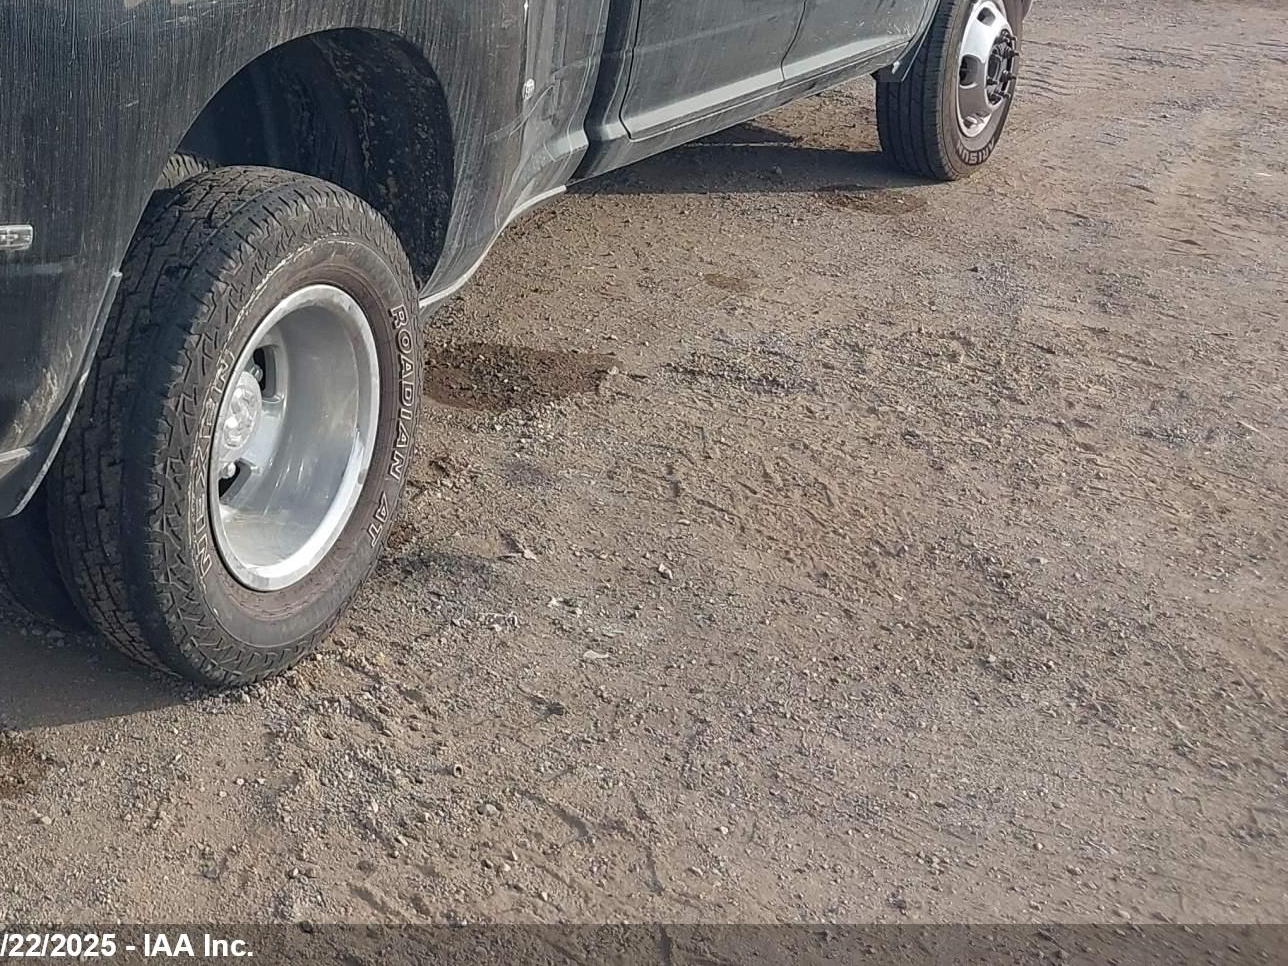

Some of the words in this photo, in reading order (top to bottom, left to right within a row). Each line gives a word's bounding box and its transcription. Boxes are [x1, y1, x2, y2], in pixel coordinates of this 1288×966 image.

[193, 349, 235, 578] NEXEN
[389, 304, 415, 482] ROADIAN
[368, 492, 391, 548] AT
